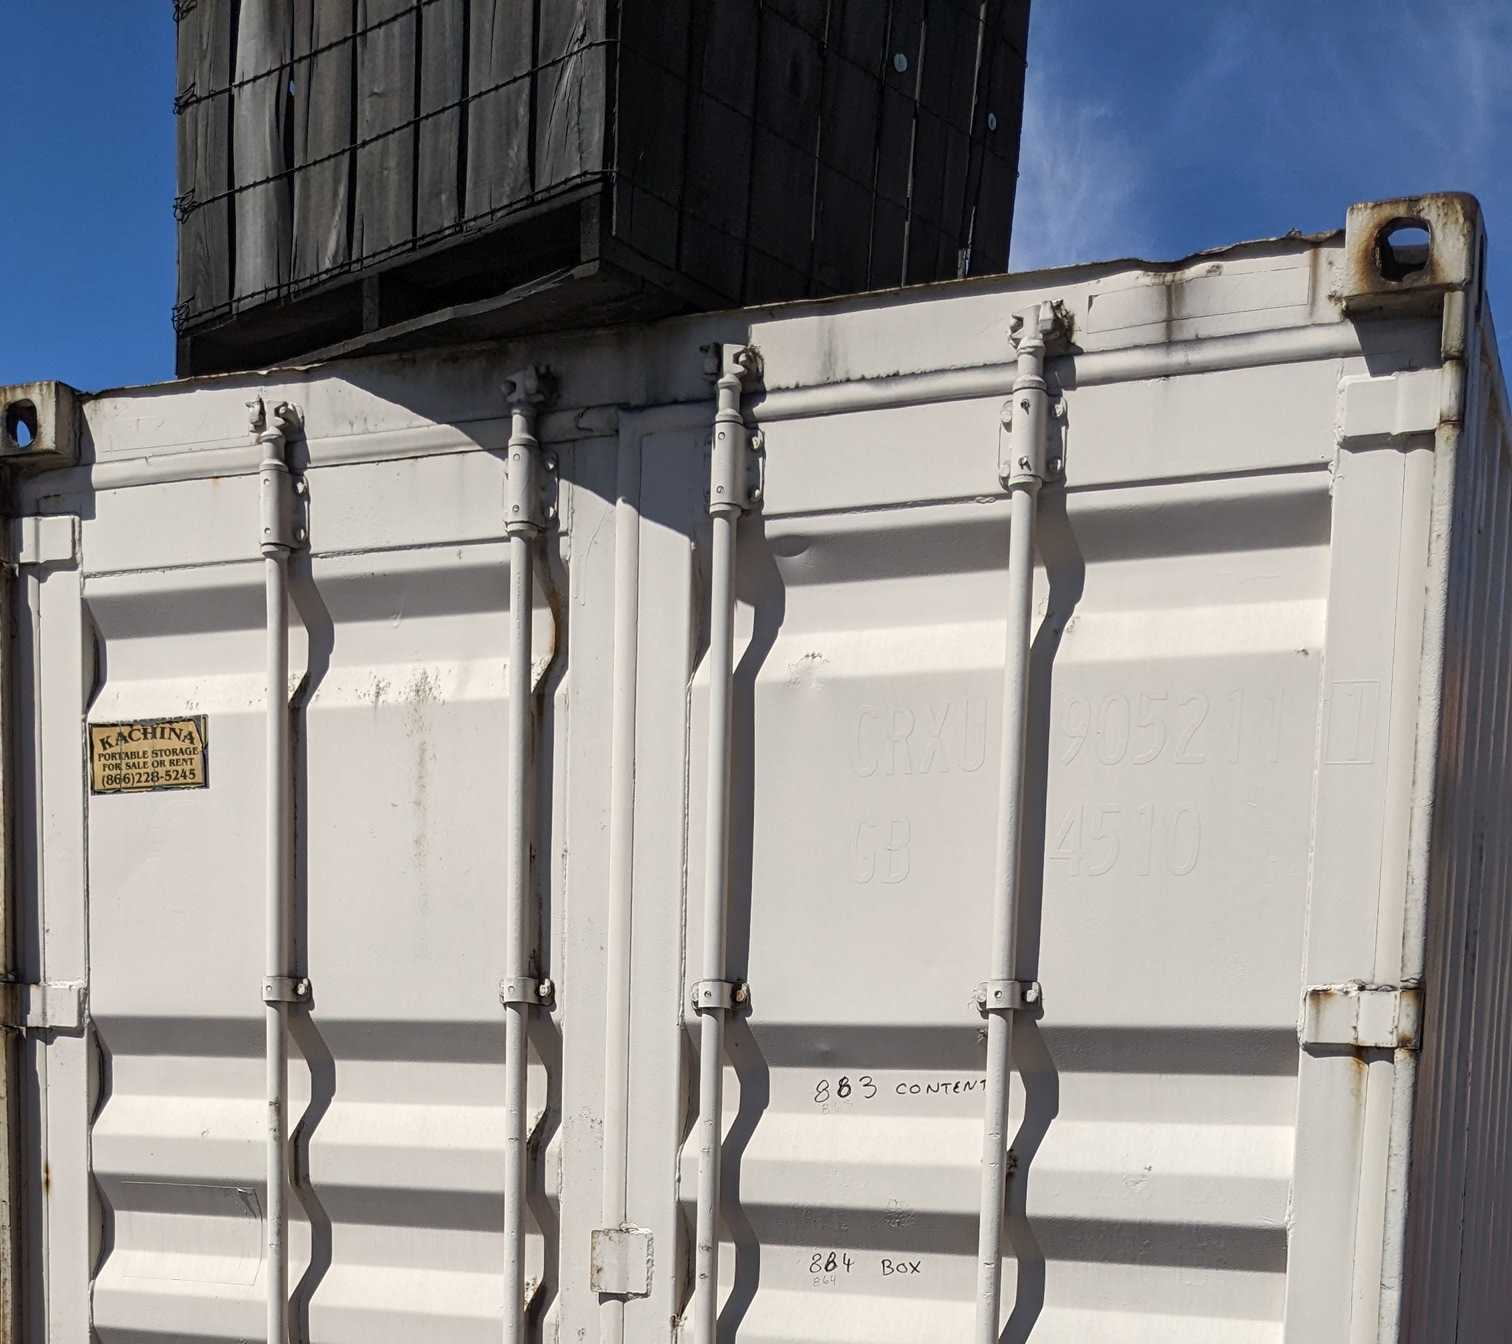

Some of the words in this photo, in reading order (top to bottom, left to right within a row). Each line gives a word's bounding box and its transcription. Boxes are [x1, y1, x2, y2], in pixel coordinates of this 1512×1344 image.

[99, 725, 196, 752] KACHINA
[853, 698, 988, 778] CRXU
[98, 750, 149, 762] PORTABLE
[151, 746, 200, 759] STORAGE
[102, 762, 122, 772] FOR
[125, 760, 149, 771] SALE
[151, 759, 167, 769] OR
[169, 757, 195, 768] RENT
[101, 768, 196, 788] (866)228-5245
[1048, 804, 1203, 878] 4510
[881, 1258, 922, 1276] BOX
